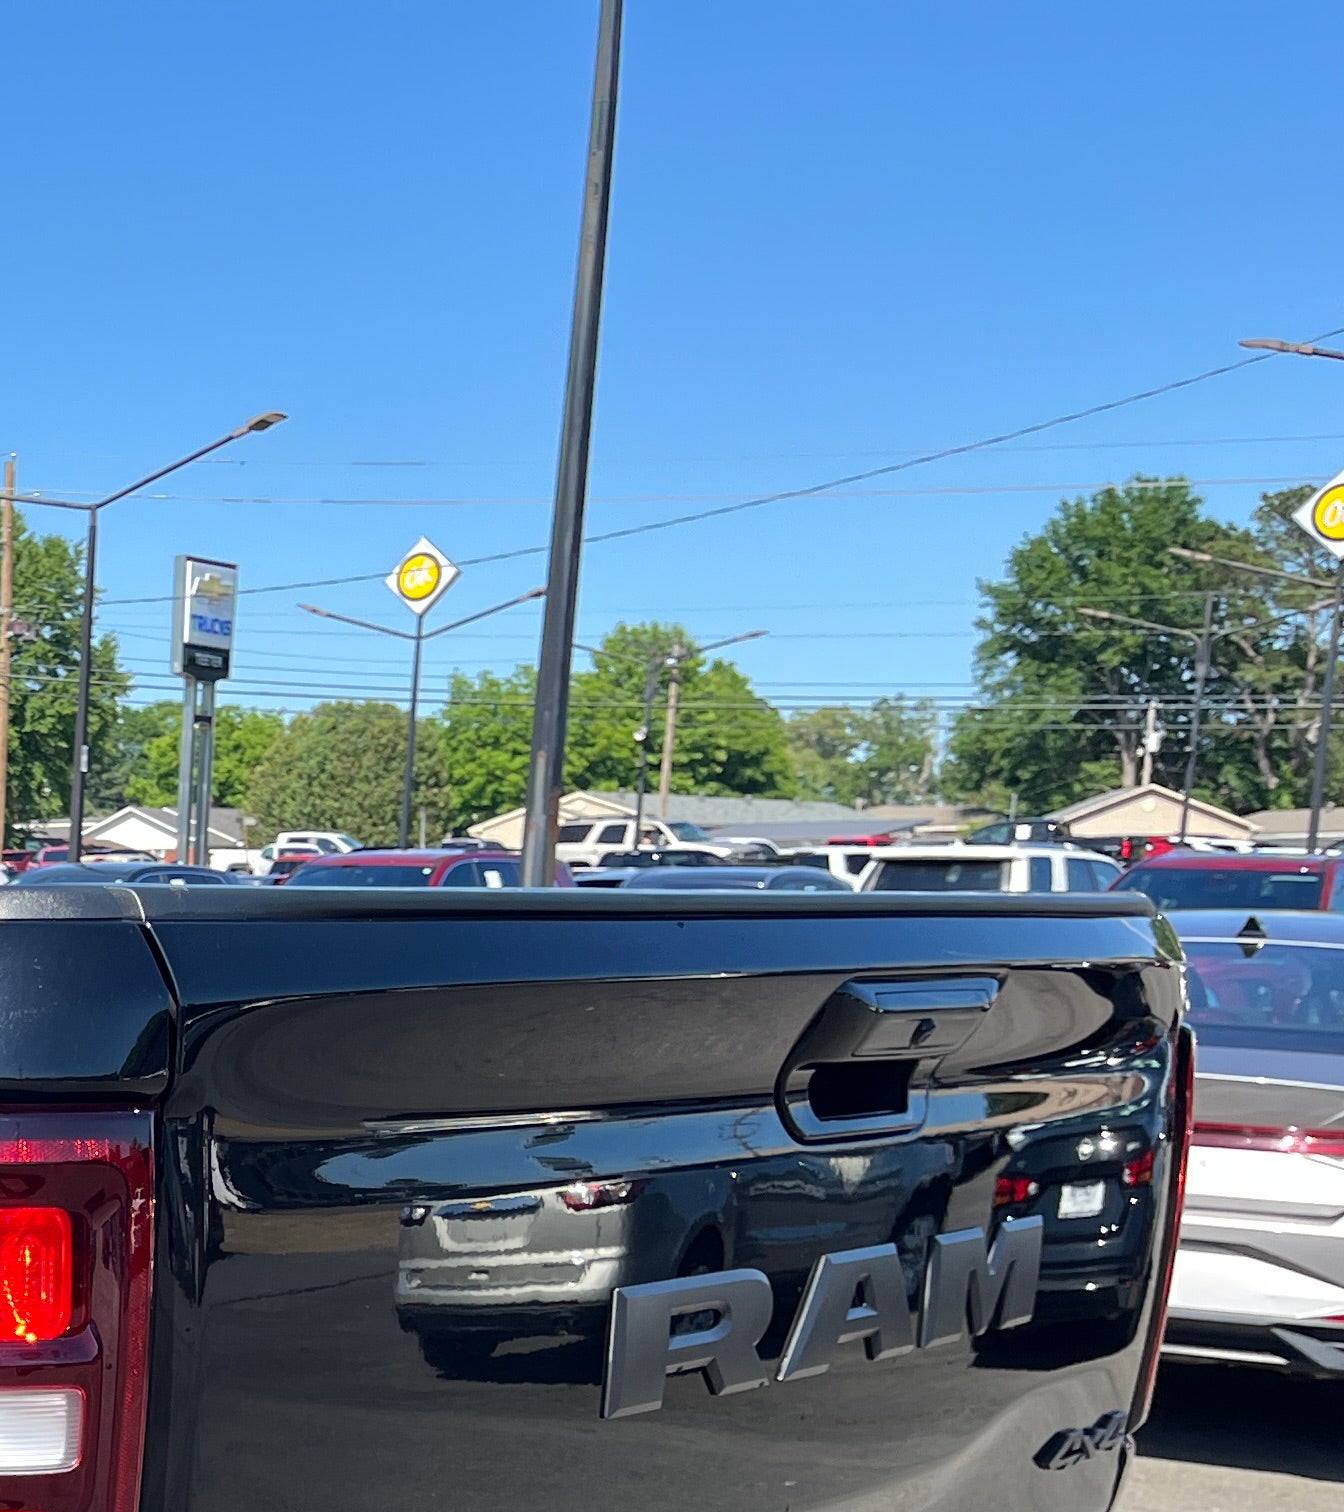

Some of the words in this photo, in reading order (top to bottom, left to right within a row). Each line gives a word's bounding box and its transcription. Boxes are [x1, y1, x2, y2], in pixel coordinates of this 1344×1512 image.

[1323, 499, 1344, 529] O
[405, 558, 435, 590] OK
[191, 613, 232, 637] TRUCKS
[601, 1214, 1044, 1420] RAM
